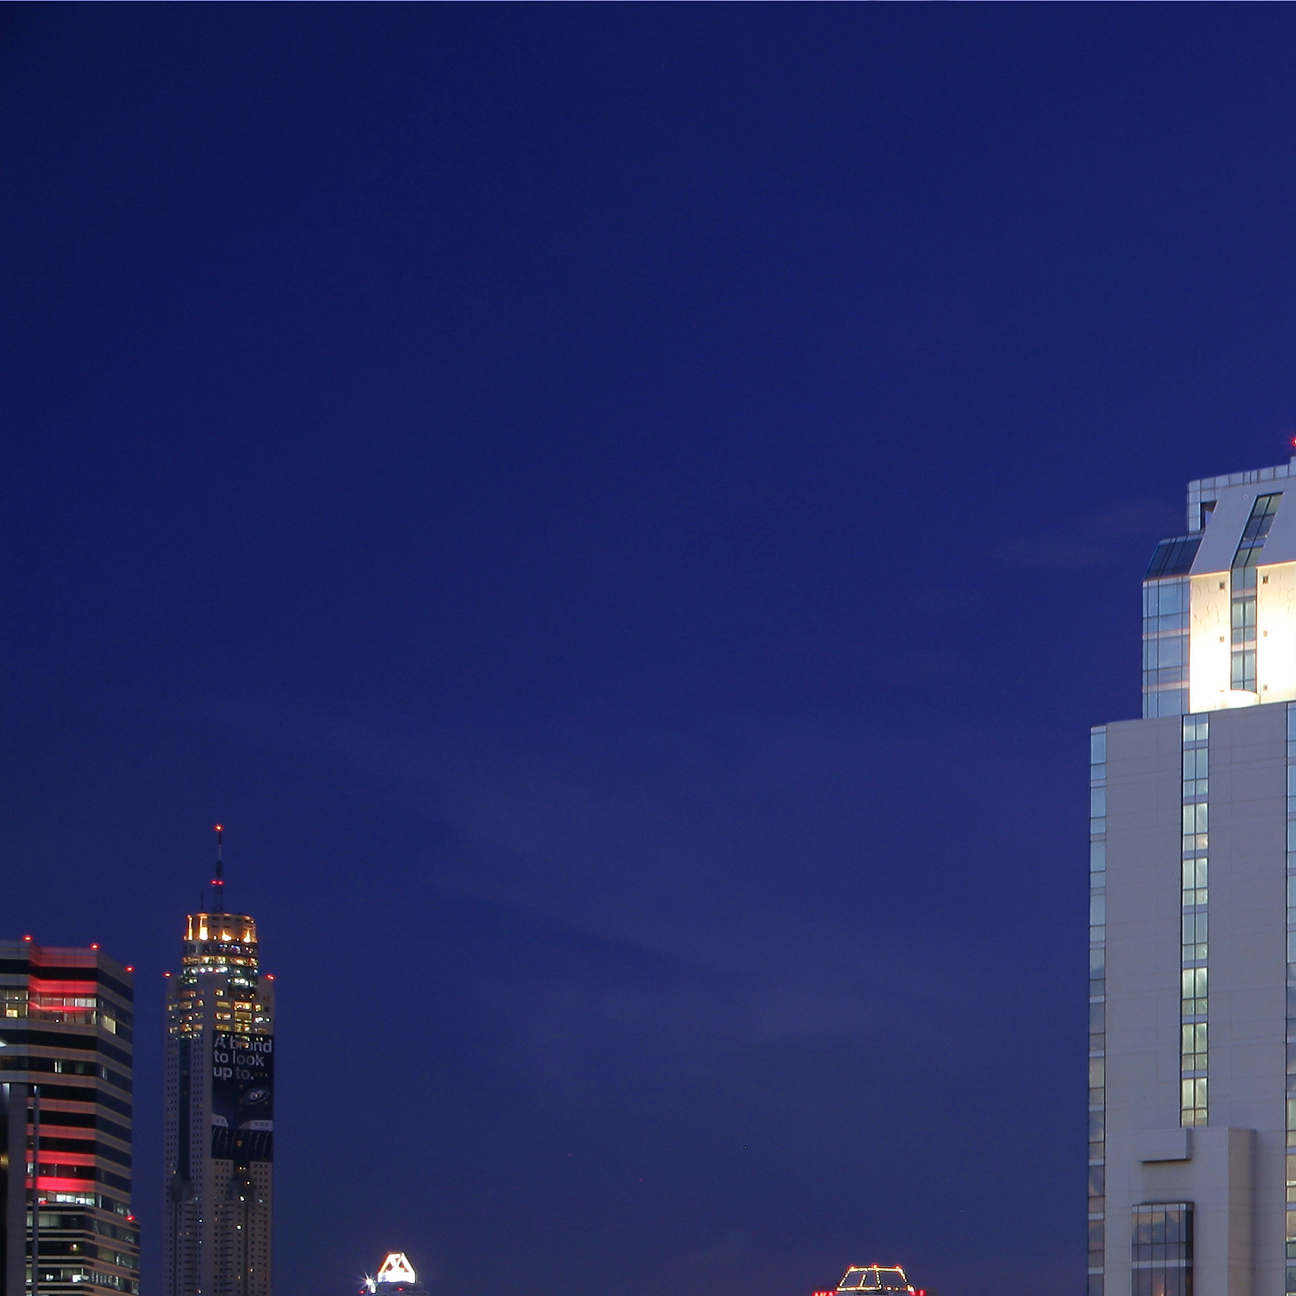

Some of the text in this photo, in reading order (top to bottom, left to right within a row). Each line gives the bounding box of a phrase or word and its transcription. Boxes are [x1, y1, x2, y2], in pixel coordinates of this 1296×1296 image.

[214, 1035, 273, 1053] A brand
[213, 1050, 265, 1067] to look
[213, 1066, 254, 1080] up to.
